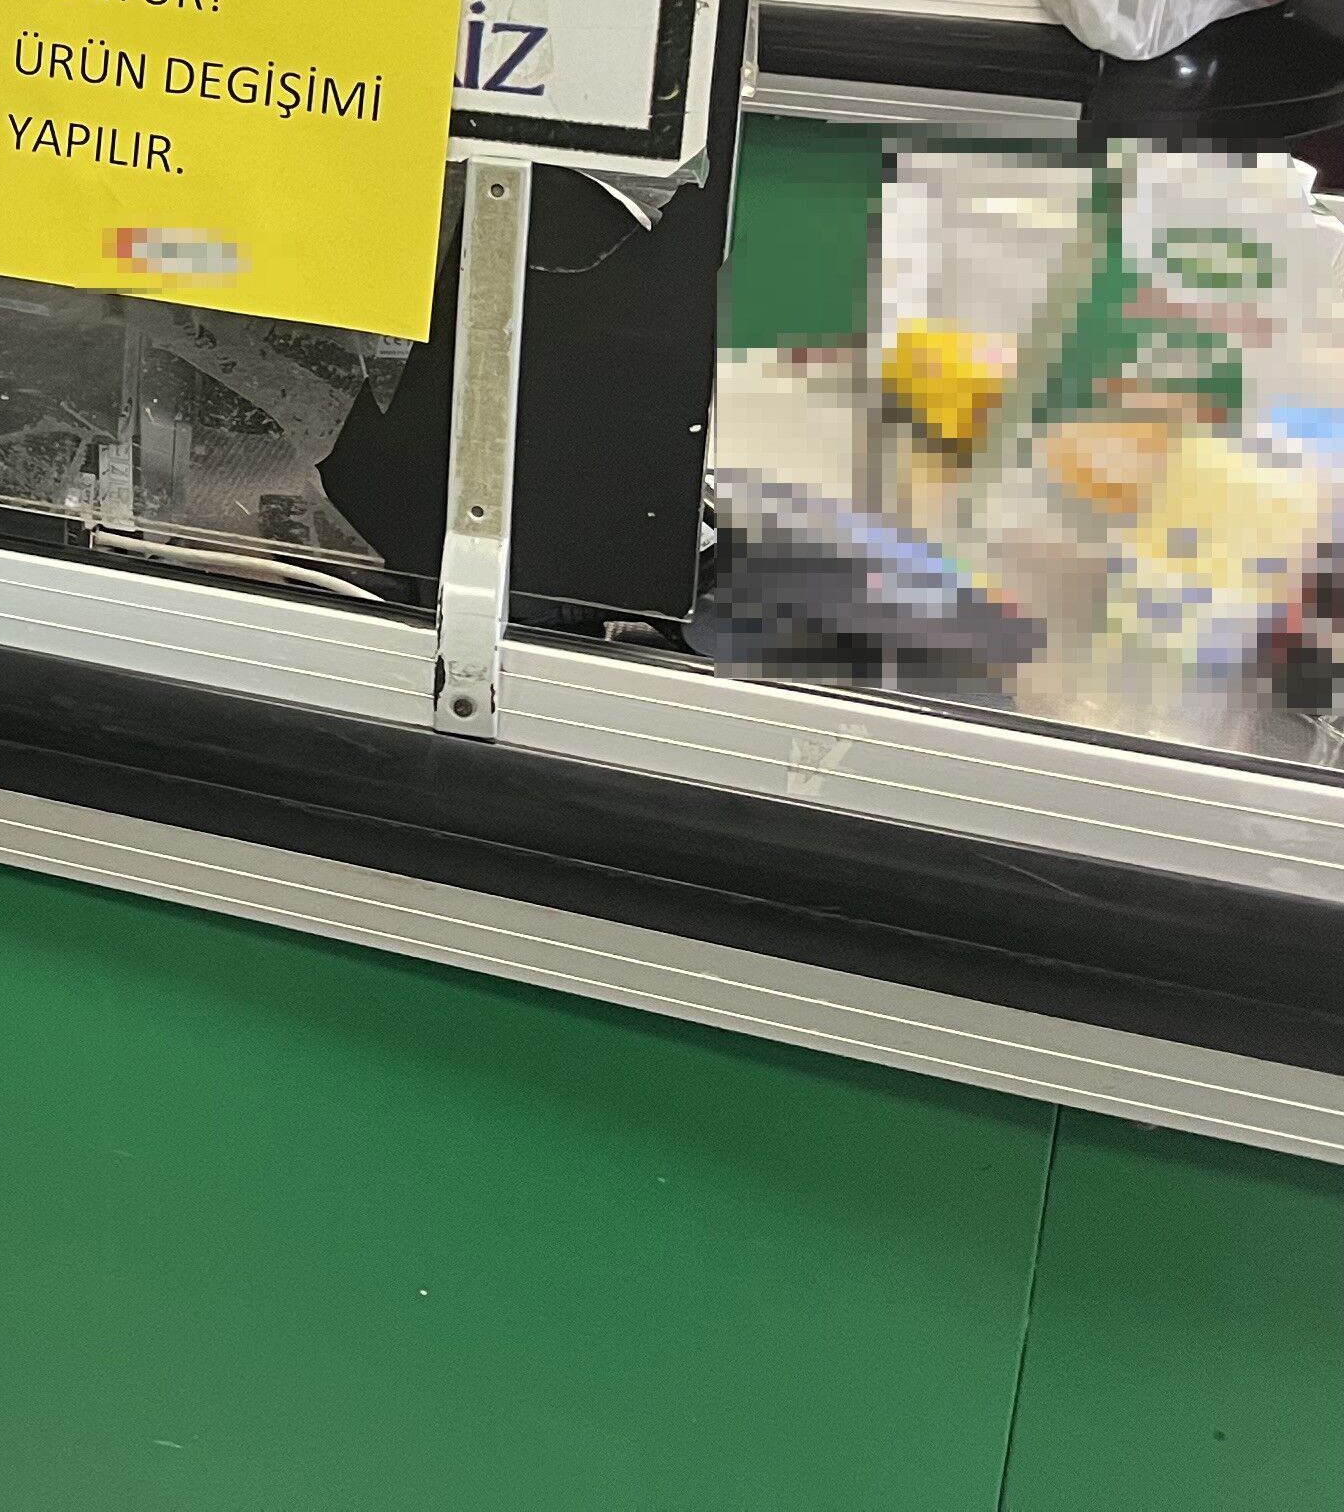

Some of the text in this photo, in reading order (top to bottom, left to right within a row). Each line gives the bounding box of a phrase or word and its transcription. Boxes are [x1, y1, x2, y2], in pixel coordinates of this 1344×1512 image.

[14, 30, 147, 90] ÜRÜN
[454, 0, 549, 98] İZ
[7, 113, 185, 175] YAPILIR.
